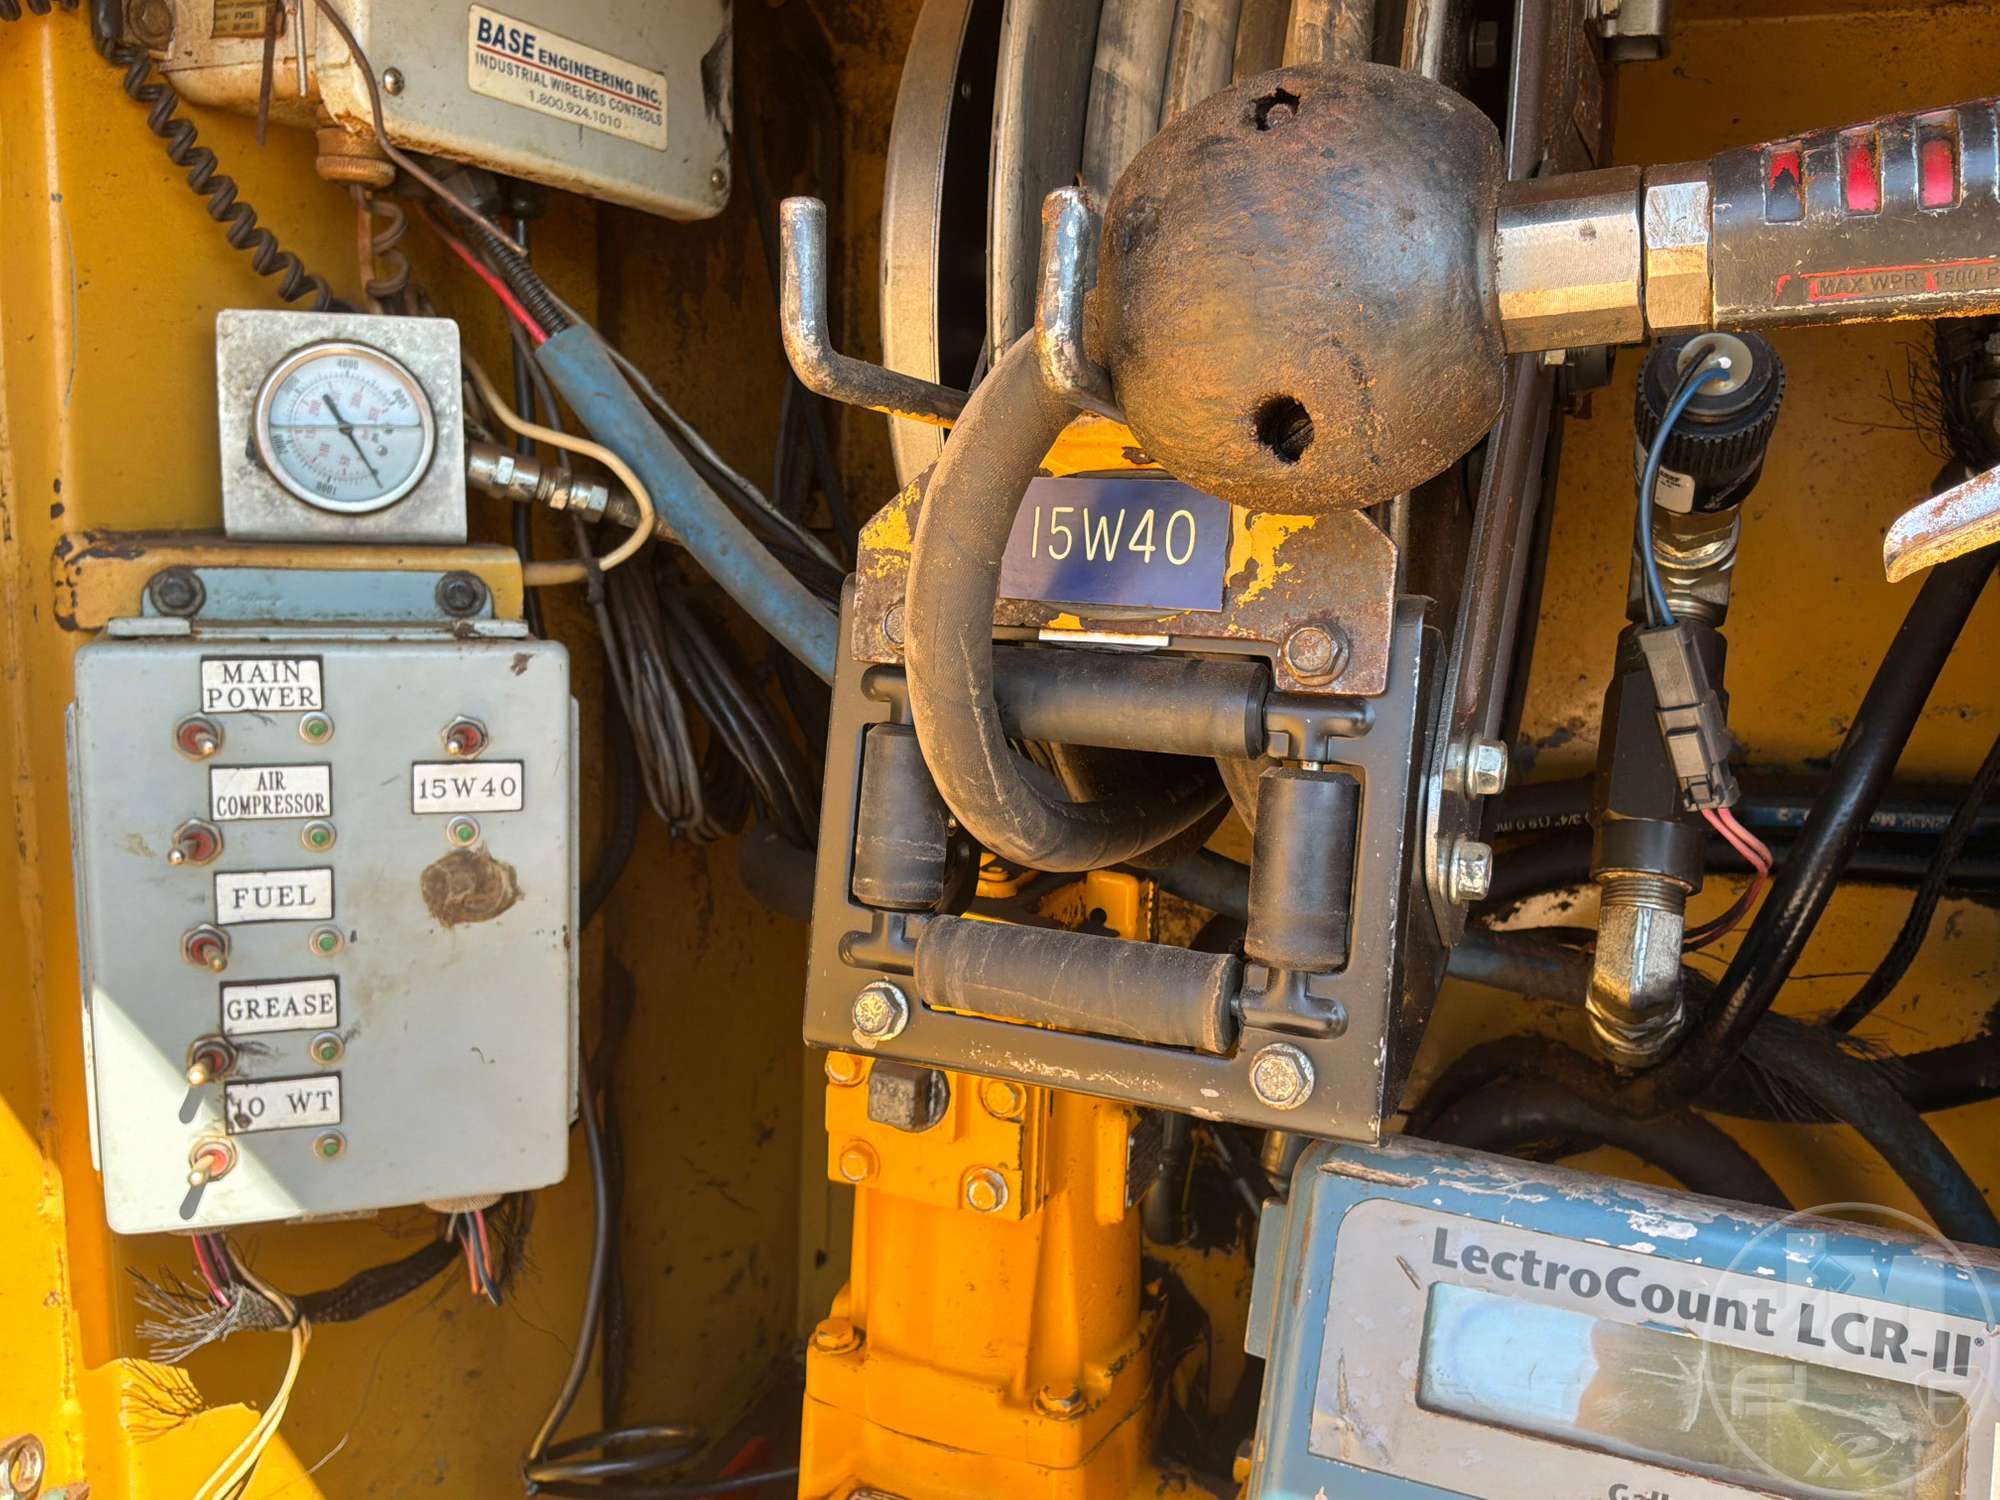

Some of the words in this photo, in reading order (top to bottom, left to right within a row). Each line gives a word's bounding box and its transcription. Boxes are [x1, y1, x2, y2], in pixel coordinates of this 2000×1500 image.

[476, 17, 536, 59] BASE
[538, 48, 634, 95] ENGINEERING
[475, 52, 548, 88] INDUSTRIAL
[550, 78, 607, 107] WIRELESS
[608, 98, 662, 127] CONTROLS
[528, 90, 622, 129] 1.800.924.1010
[1869, 273, 1918, 291] WPR
[1031, 506, 1196, 566] 15W40
[222, 662, 301, 685] MAIN
[206, 686, 318, 709] POWER
[256, 771, 286, 792] AIR
[419, 777, 517, 799] 15W40
[217, 793, 326, 816] COMPRESSOR
[232, 884, 316, 909] FUEL
[226, 993, 335, 1021] GREASE
[287, 1089, 334, 1114] WT
[1432, 1227, 1776, 1337] LectroCount
